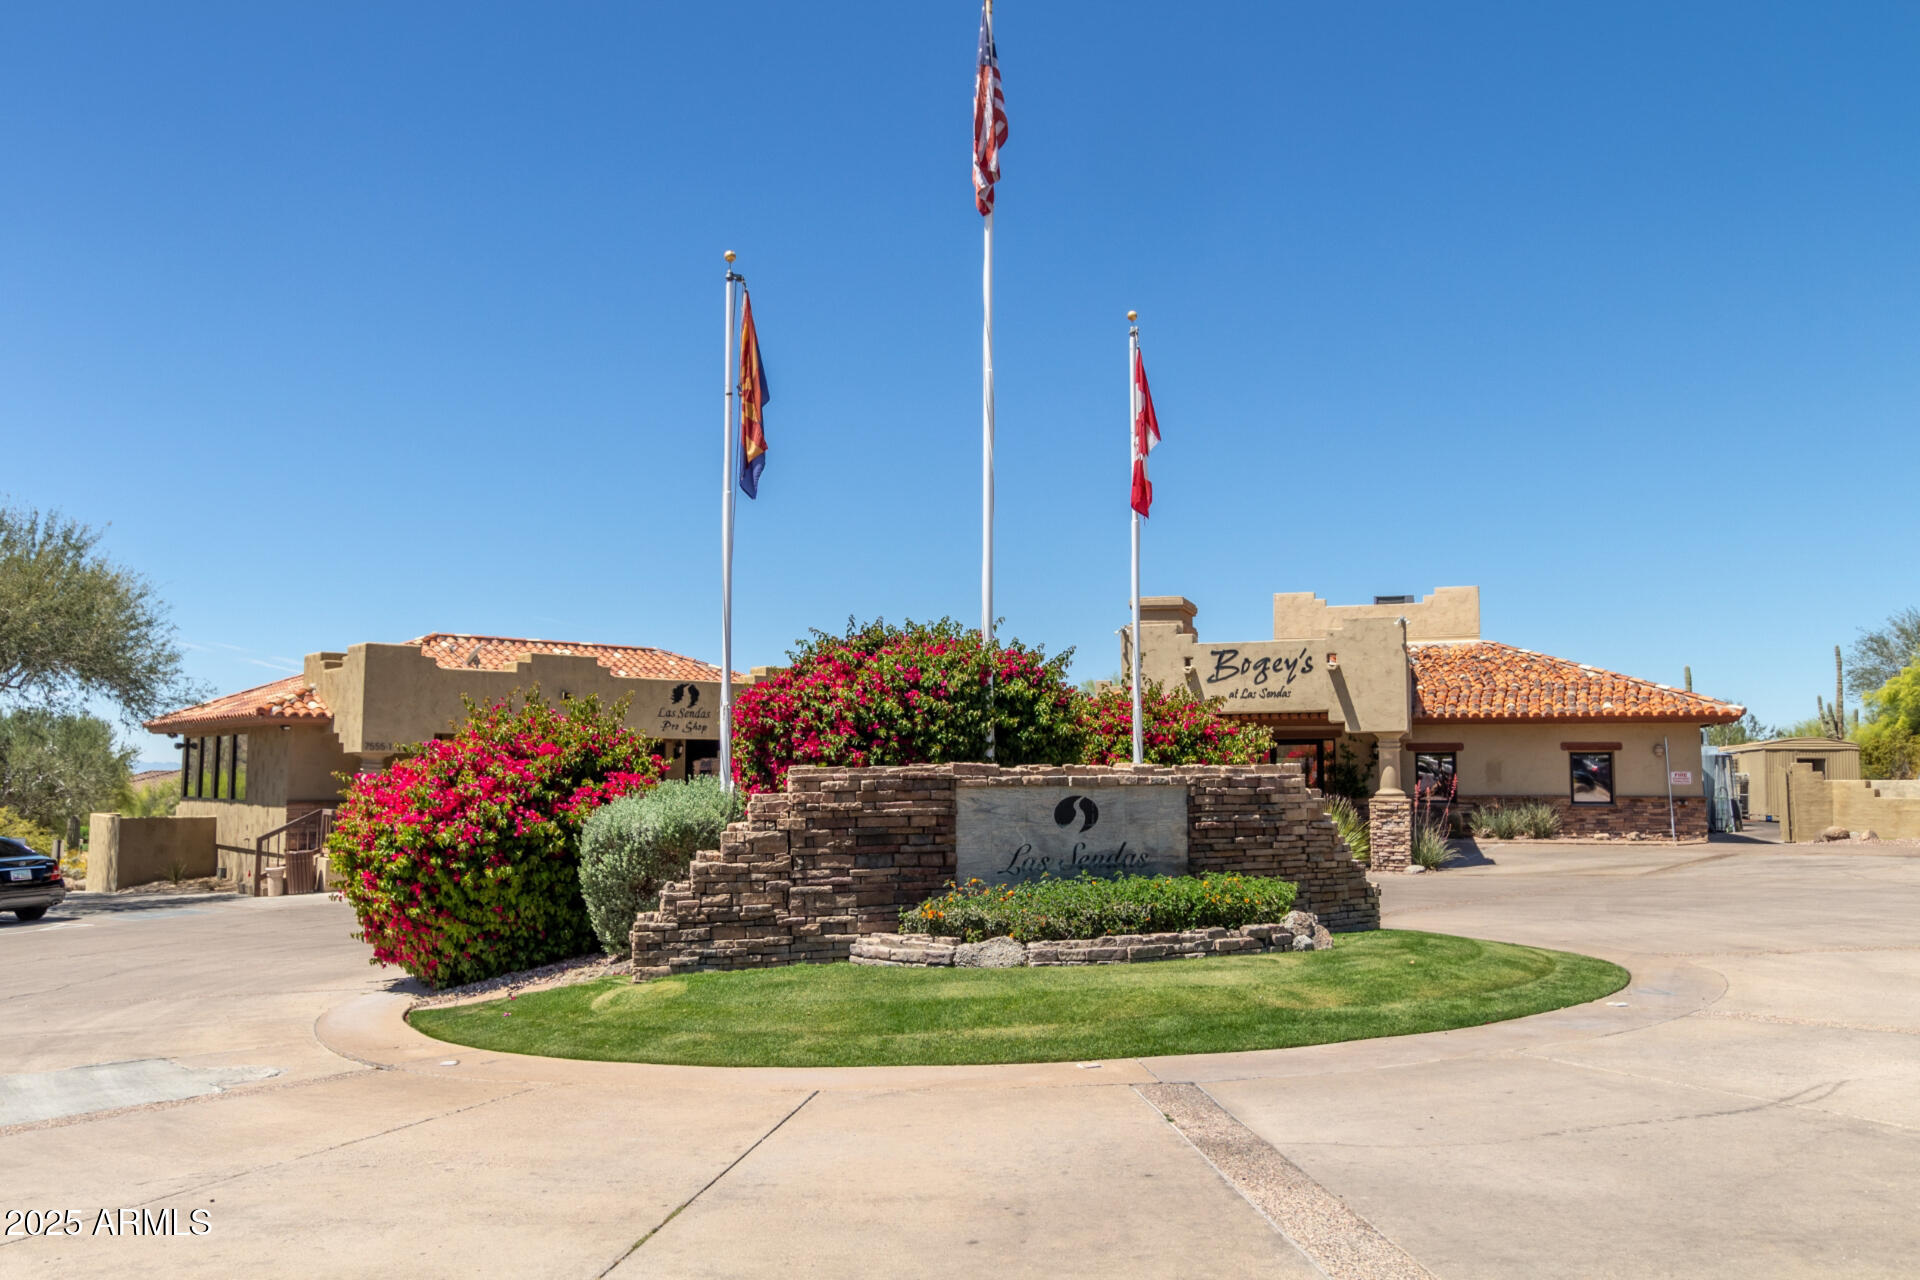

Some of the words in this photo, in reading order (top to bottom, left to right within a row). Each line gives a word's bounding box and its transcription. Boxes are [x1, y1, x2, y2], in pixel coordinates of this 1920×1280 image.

[1206, 648, 1314, 685] Bogey's
[1228, 688, 1238, 699] at
[1240, 688, 1256, 699] Las
[1259, 686, 1292, 699] Sendas
[657, 707, 675, 718] Las
[677, 707, 711, 719] Sendas
[661, 720, 679, 731] Pro
[681, 721, 708, 734] Shop
[997, 843, 1050, 876] Las
[1057, 841, 1149, 871] Sendas
